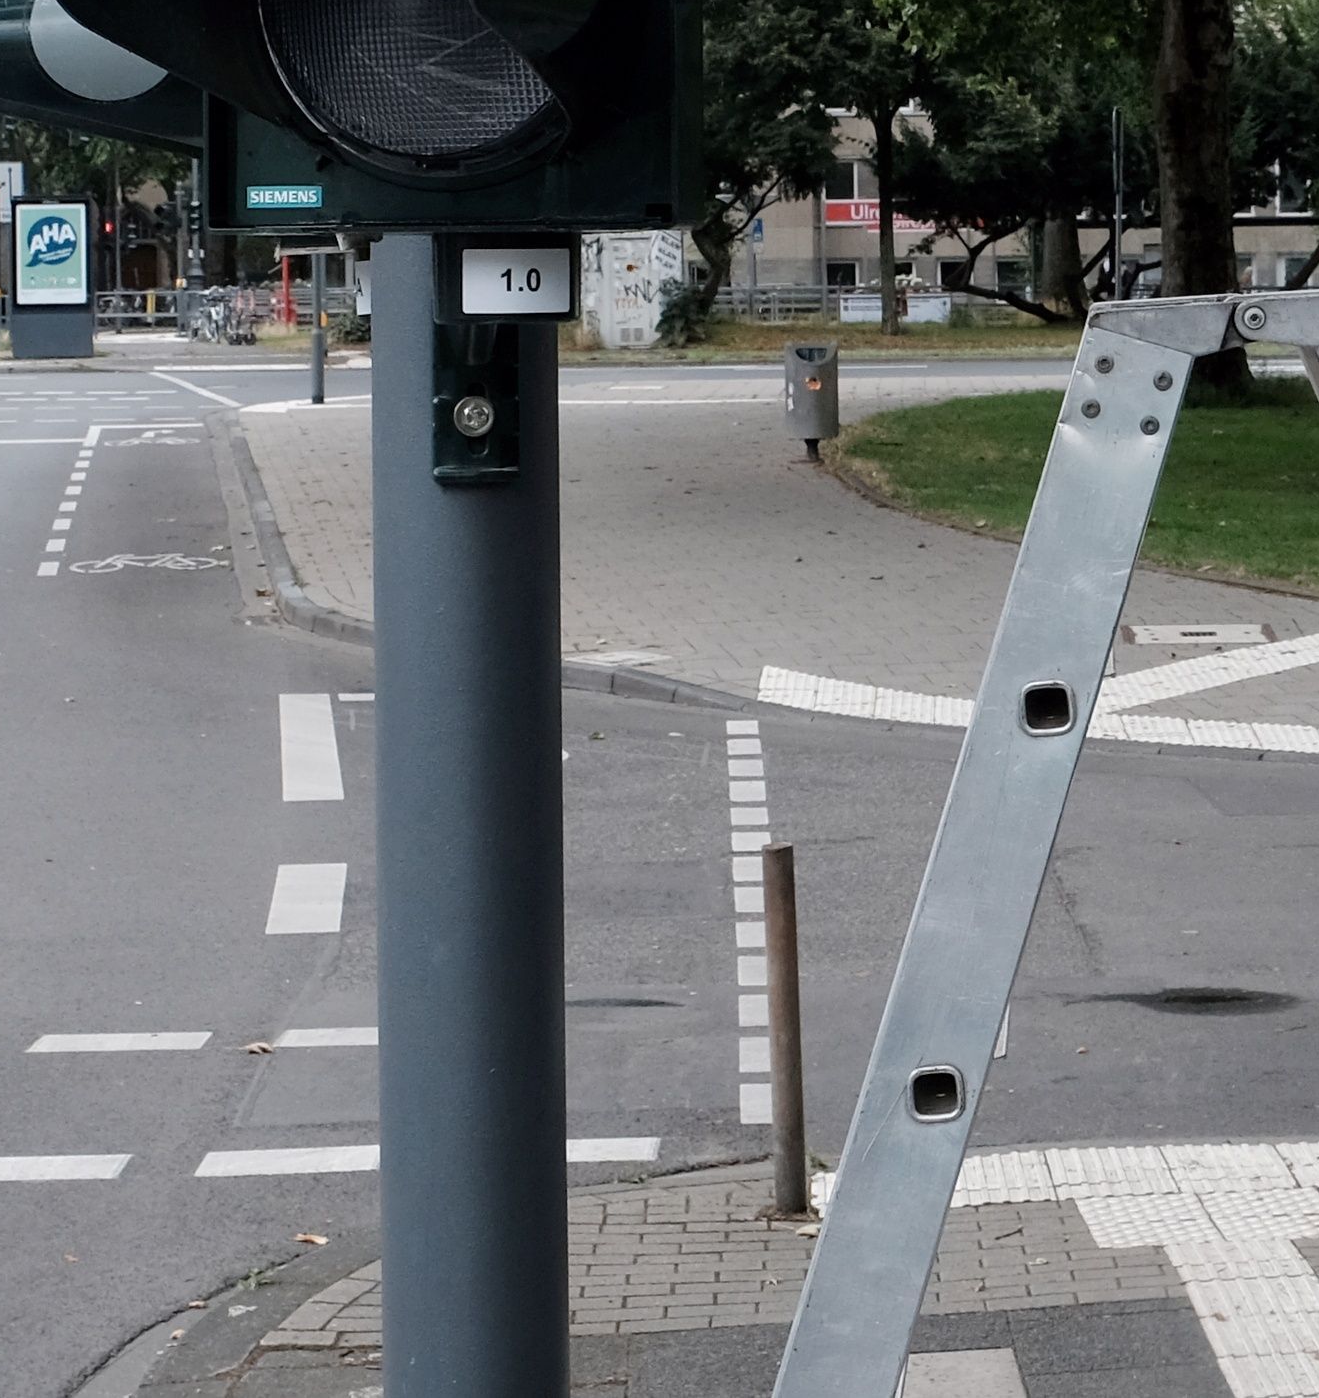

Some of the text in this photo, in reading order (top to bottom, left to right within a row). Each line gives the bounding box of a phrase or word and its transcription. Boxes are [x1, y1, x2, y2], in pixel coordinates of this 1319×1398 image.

[249, 189, 318, 204] SIEMENS
[29, 222, 76, 255] AHA
[500, 267, 542, 293] 1.0
